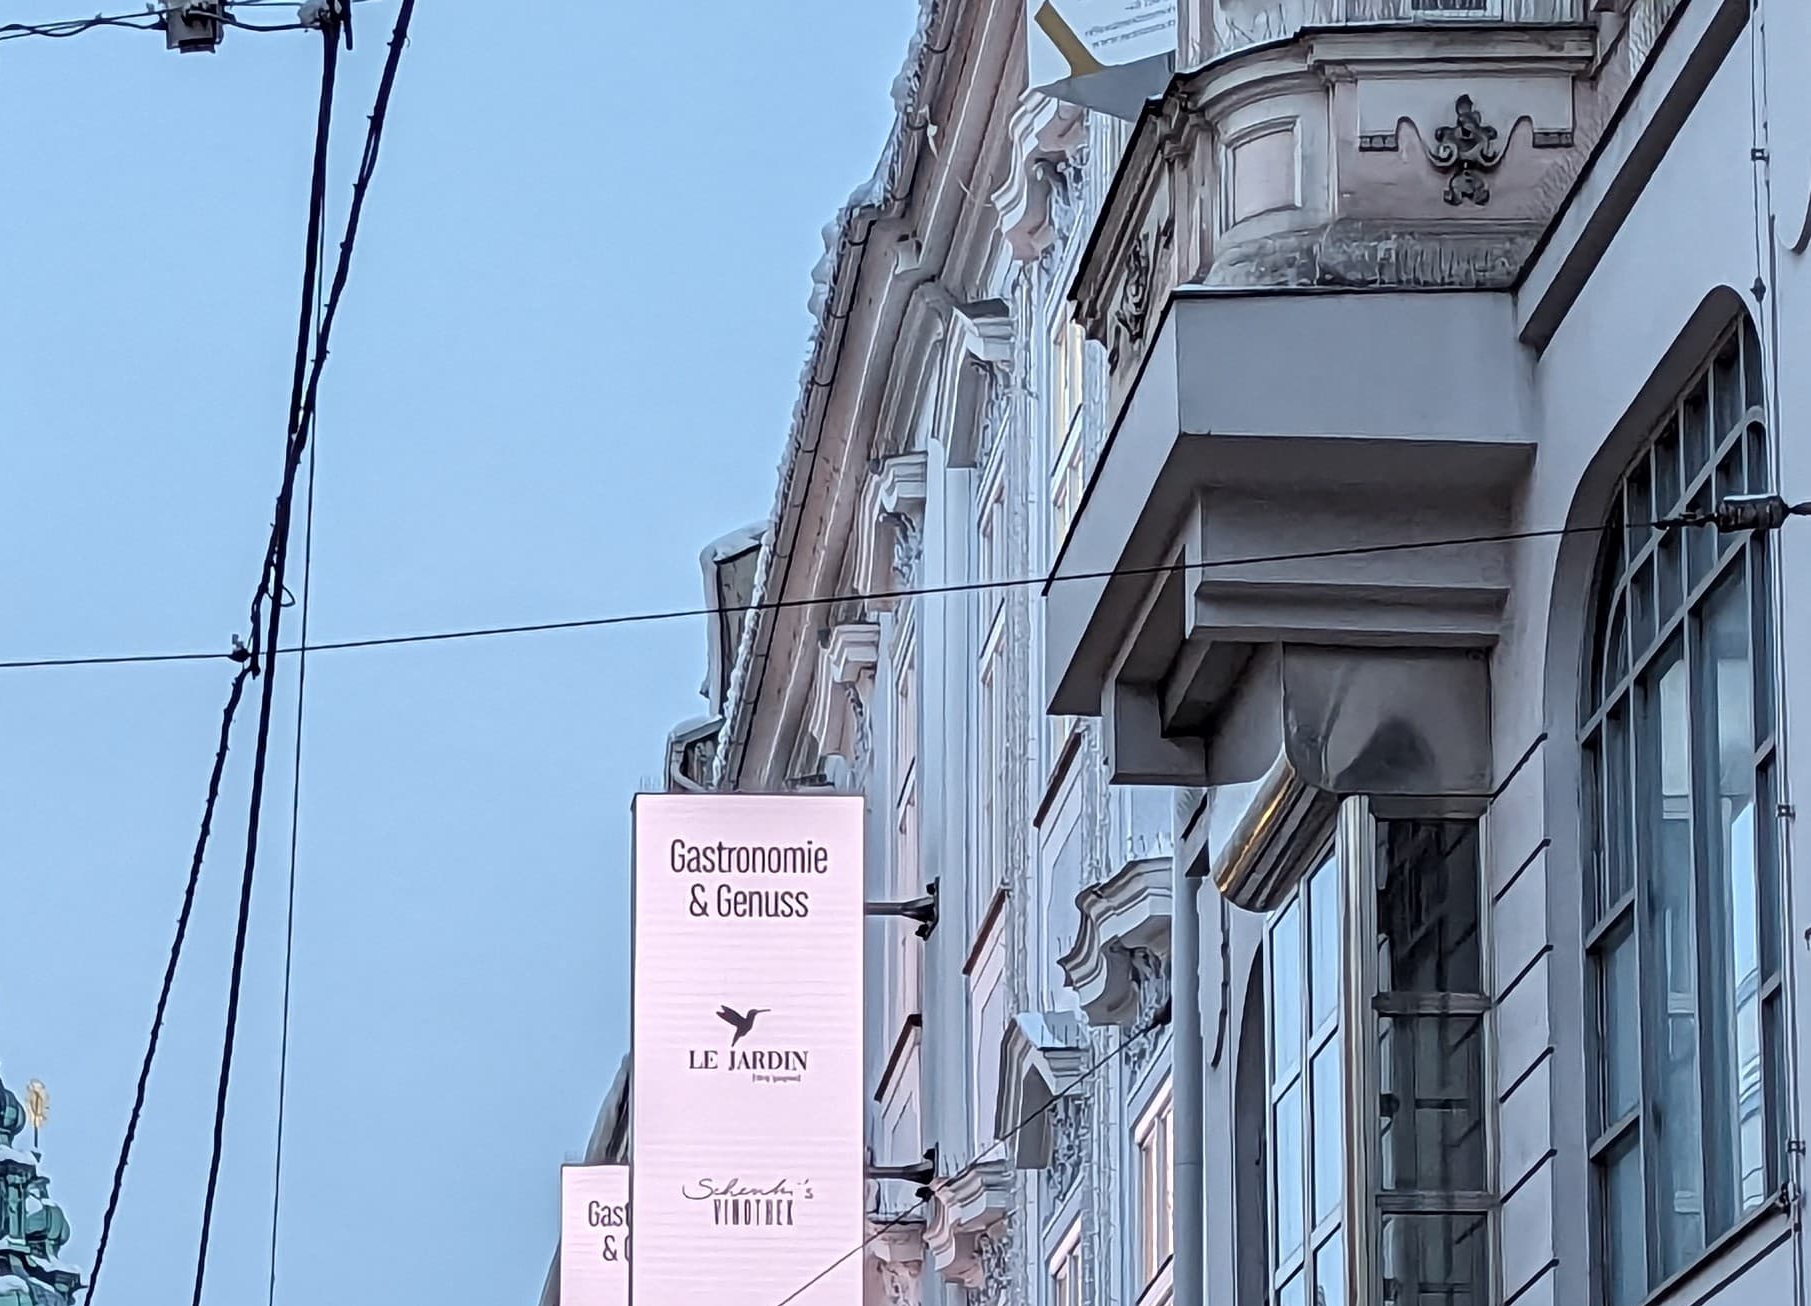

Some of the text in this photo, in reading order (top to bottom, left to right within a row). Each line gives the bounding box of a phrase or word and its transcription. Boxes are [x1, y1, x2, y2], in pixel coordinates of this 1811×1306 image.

[671, 839, 828, 873] Gastronomie
[690, 883, 809, 917] & Genuss
[689, 1050, 809, 1071] LE JARDIN
[713, 1199, 793, 1226] VINOTHEK
